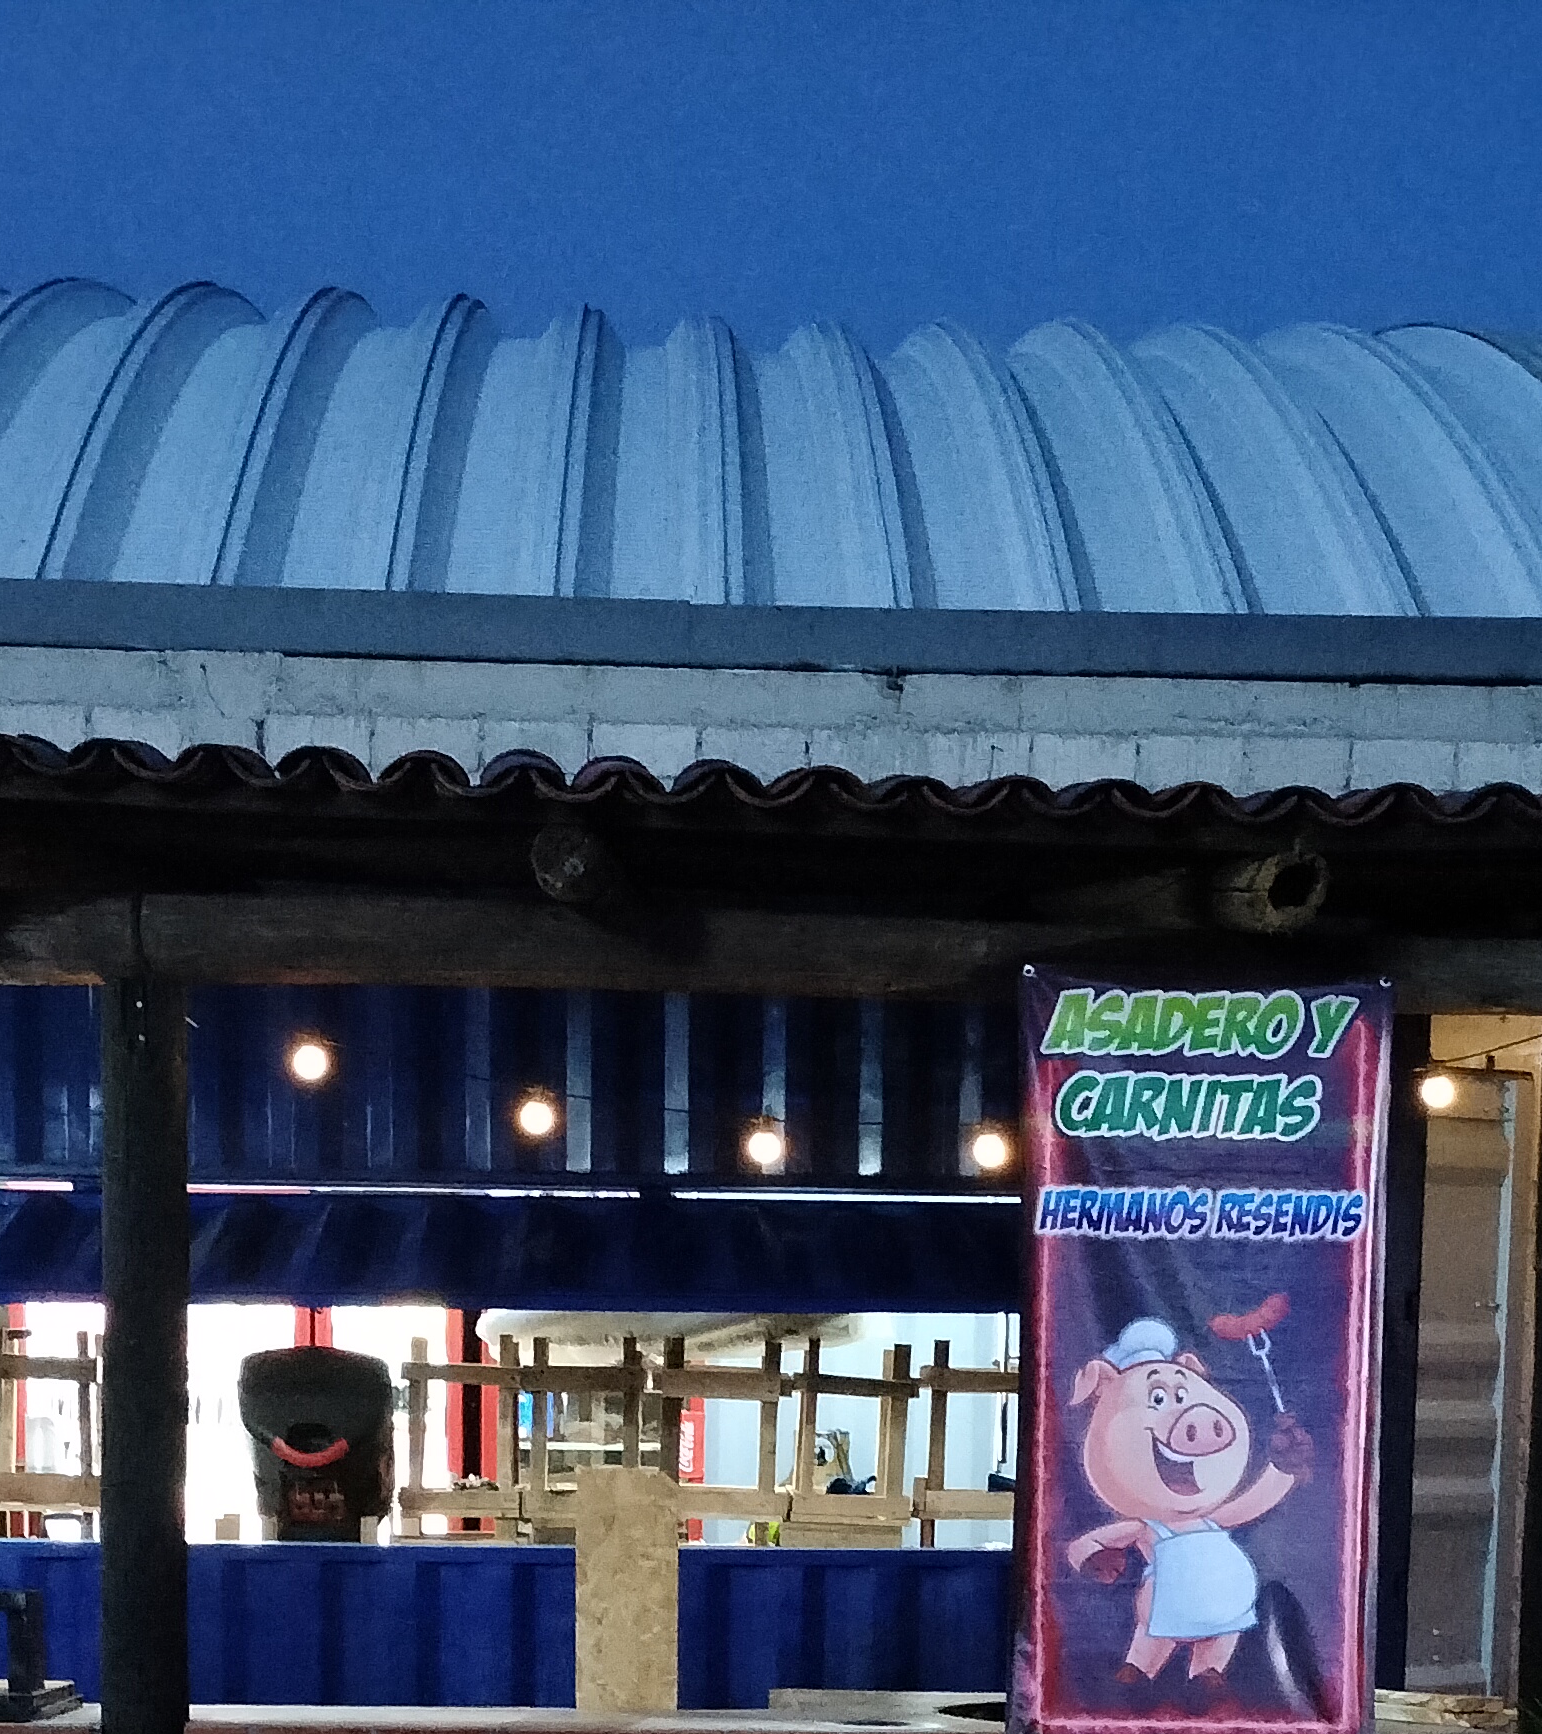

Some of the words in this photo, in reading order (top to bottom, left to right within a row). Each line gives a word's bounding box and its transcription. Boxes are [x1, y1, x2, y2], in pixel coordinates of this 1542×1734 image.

[1040, 989, 1304, 1060] ASADERO
[1308, 996, 1359, 1058] Y
[1057, 1071, 1322, 1141] CARNITAS
[1035, 1185, 1213, 1238] HERMANOS
[1211, 1188, 1365, 1241] RESENDIS
